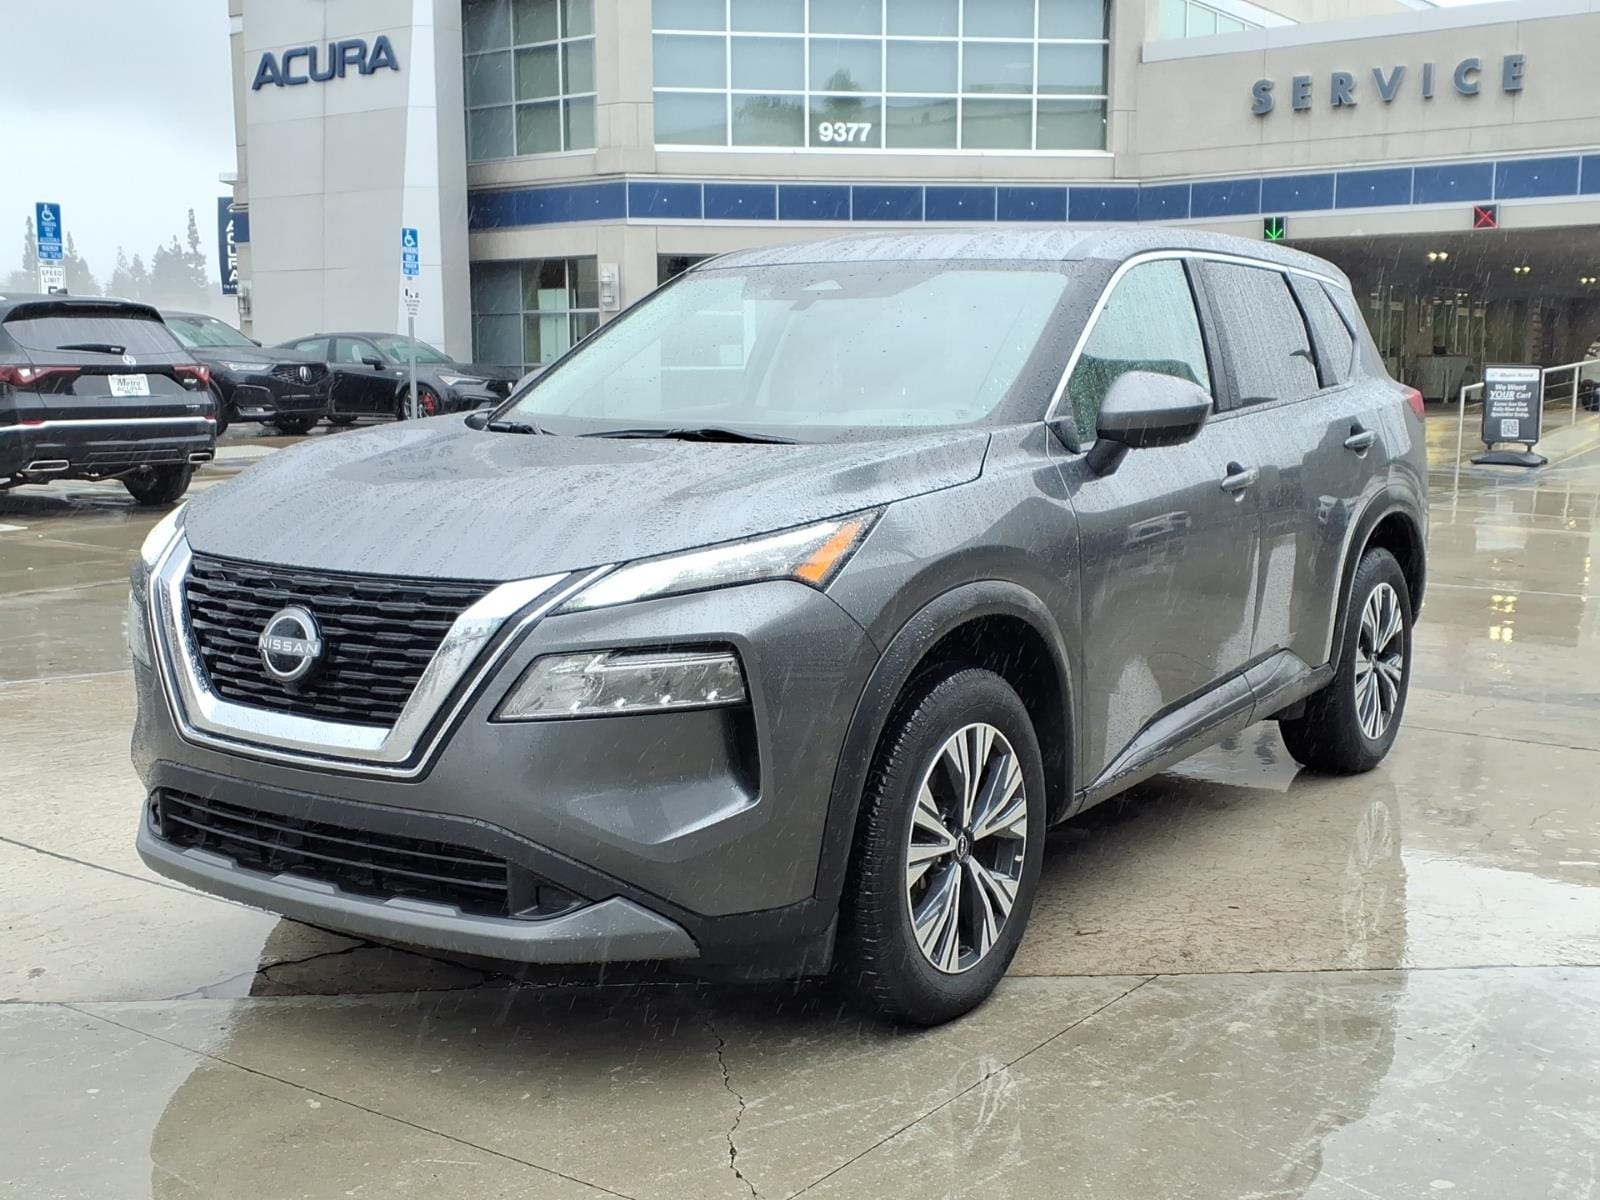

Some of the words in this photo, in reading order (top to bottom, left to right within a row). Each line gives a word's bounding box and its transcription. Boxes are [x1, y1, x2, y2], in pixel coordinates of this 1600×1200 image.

[252, 35, 400, 91] ACURA
[1251, 54, 1525, 116] SERVICE
[819, 121, 872, 142] 9377
[41, 269, 63, 277] SPEED
[117, 378, 141, 386] Metro
[1490, 390, 1515, 400] YOUR
[1516, 391, 1532, 399] Car!
[259, 636, 318, 654] NISSAN
